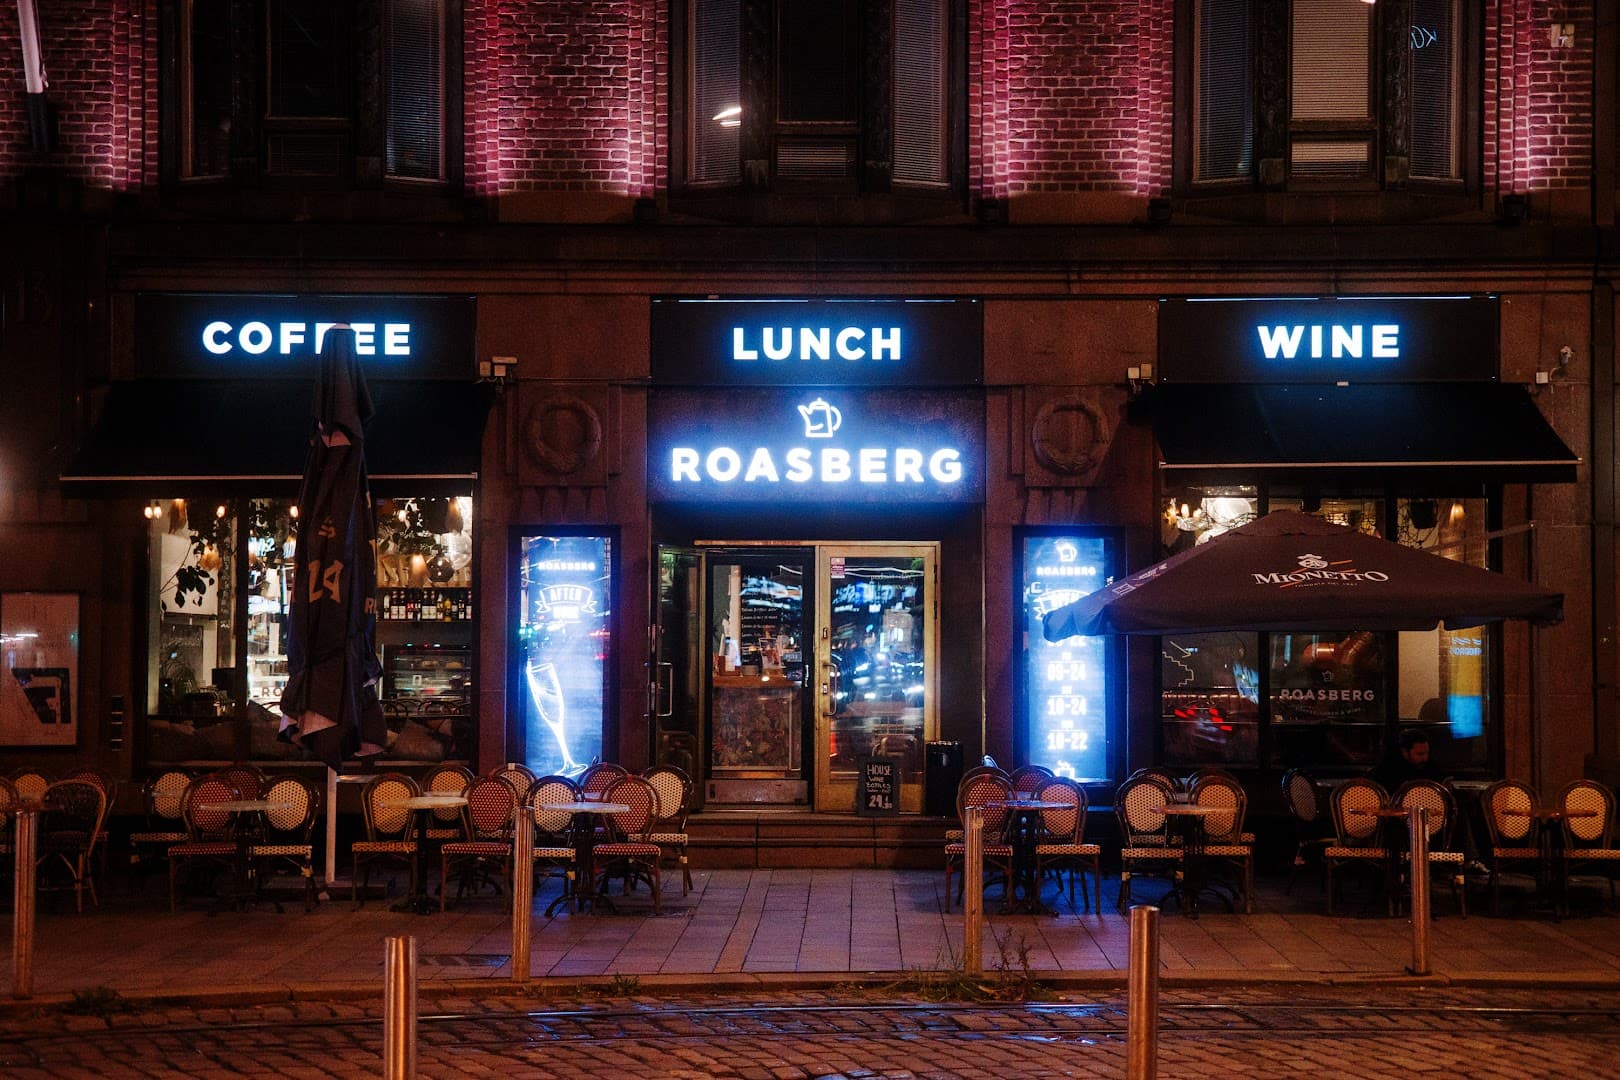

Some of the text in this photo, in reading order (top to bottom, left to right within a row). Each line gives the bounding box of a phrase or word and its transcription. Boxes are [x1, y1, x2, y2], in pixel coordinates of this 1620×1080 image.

[733, 327, 901, 360] LUNCH
[1257, 325, 1400, 359] WINE
[672, 447, 963, 483] ROASBERG
[550, 588, 582, 602] AFTER
[1280, 689, 1375, 701] ROASBERG
